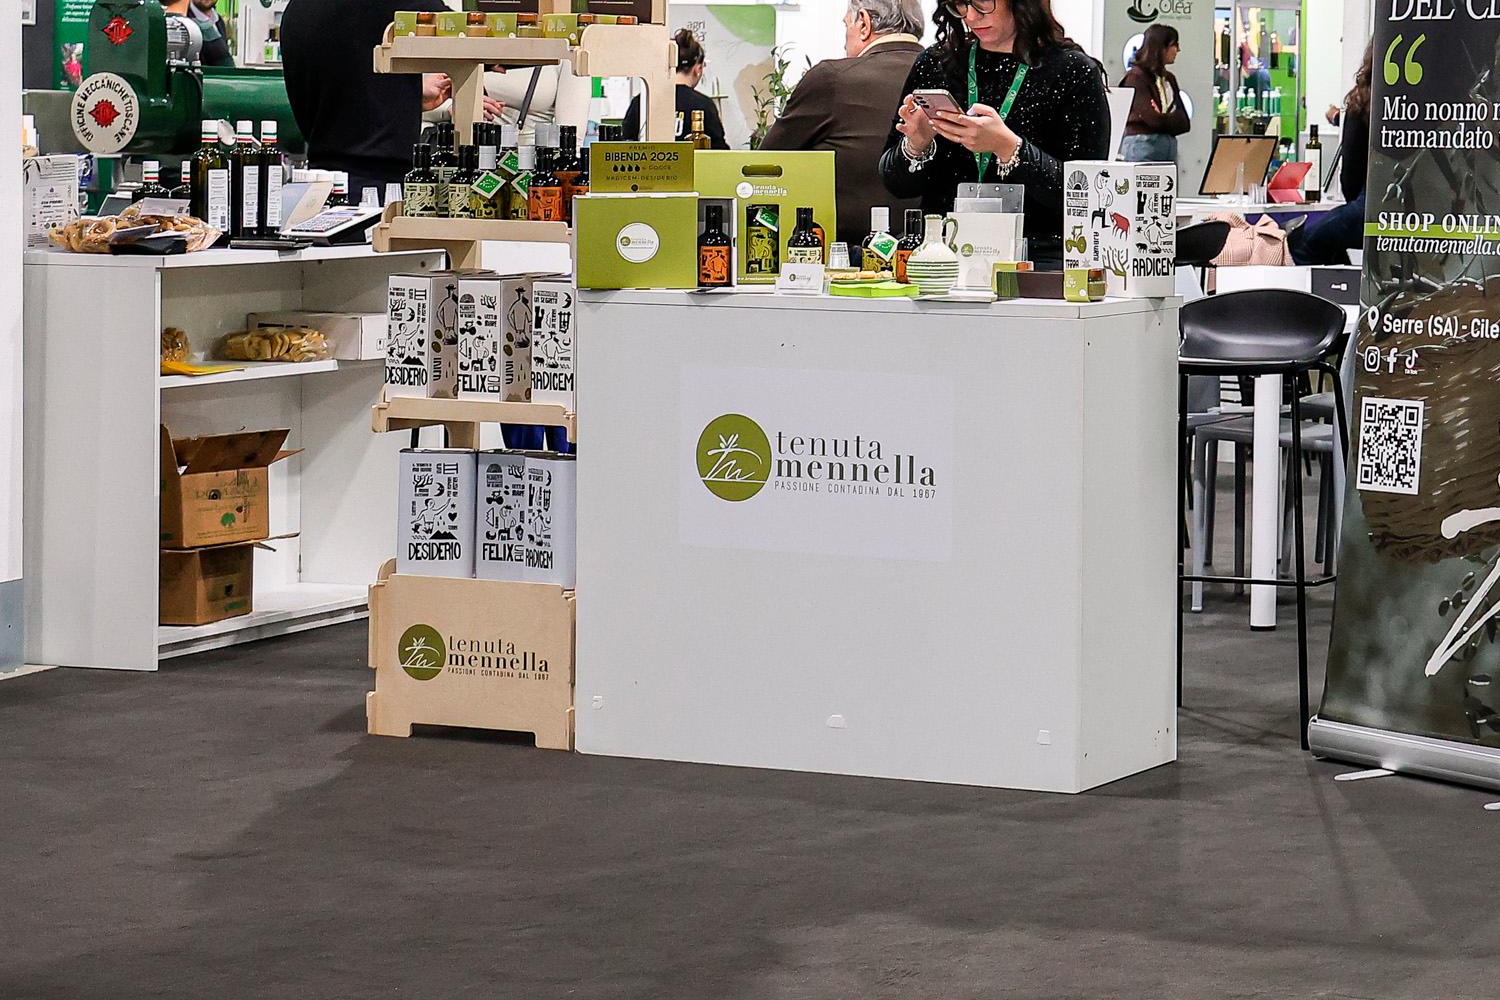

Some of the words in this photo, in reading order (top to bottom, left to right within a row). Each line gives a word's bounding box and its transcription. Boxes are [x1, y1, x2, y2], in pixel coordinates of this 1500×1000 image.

[1381, 96, 1419, 121] Mio
[1424, 102, 1489, 121] nonno
[1380, 122, 1493, 150] tramandato
[604, 151, 648, 162] BIBENDA
[650, 151, 679, 162] 2025
[1377, 211, 1435, 232] SHOP
[1133, 257, 1176, 277] RADICEM
[1382, 313, 1423, 335] Serre
[1428, 315, 1459, 338] (SA)
[385, 366, 428, 387] DESIDERIO
[457, 374, 487, 393] FELIX
[531, 371, 574, 392] RADICEM
[776, 431, 883, 460] tenuta
[775, 454, 937, 487] mennella
[774, 480, 820, 493] PASSIONE
[827, 483, 880, 496] CONTADINA
[888, 486, 904, 497] DAL
[913, 488, 936, 499] 1967
[408, 542, 461, 561] DESIDERIO
[482, 543, 514, 562] FELIX
[525, 548, 553, 570] RADICEM
[449, 635, 516, 655] tenuta
[448, 651, 549, 673] mennella
